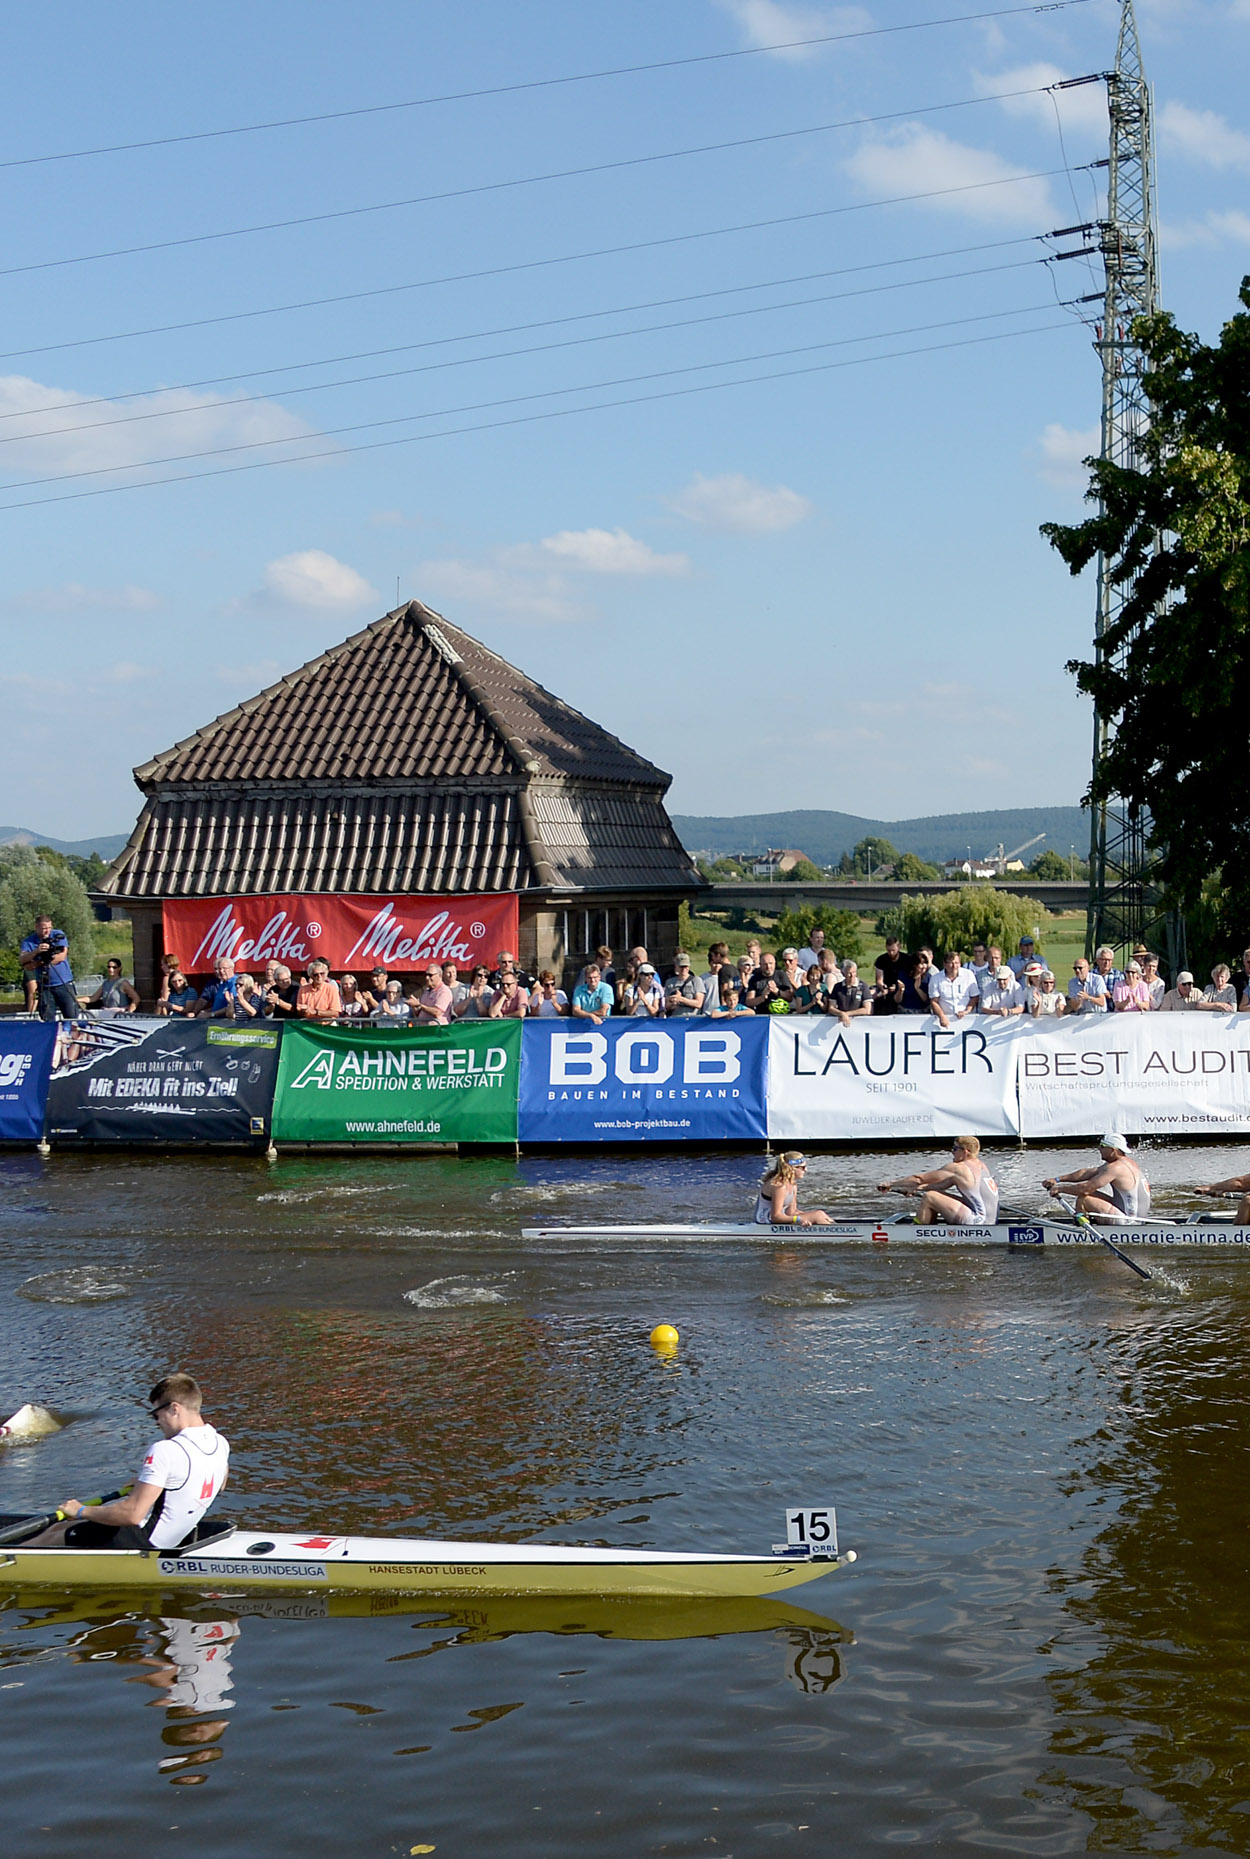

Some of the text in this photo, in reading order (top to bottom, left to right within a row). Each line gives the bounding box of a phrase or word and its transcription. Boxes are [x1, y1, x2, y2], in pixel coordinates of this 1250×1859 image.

[549, 1031, 741, 1085] BOB
[793, 1030, 993, 1076] LAUFER
[338, 1047, 507, 1076] AHNEFELD
[1024, 1051, 1129, 1077] BEST
[88, 1077, 238, 1097] Mit EDEKA fit ins Ziel!
[335, 1074, 505, 1090] SPEDITION & WERKSTATT
[866, 1082, 917, 1093] SEIT 1901
[548, 1089, 740, 1100] BAUEN IM BESTAND
[345, 1120, 441, 1133] www.ahnefeld.de
[594, 1119, 691, 1130] www.bob-projektbau.de
[916, 1229, 992, 1238] SECU INFRA
[791, 1512, 830, 1542] 15
[177, 1561, 325, 1577] RBL RUDER-BUNDESLIGA
[369, 1563, 487, 1576] HANSESTADT LÜBECK
